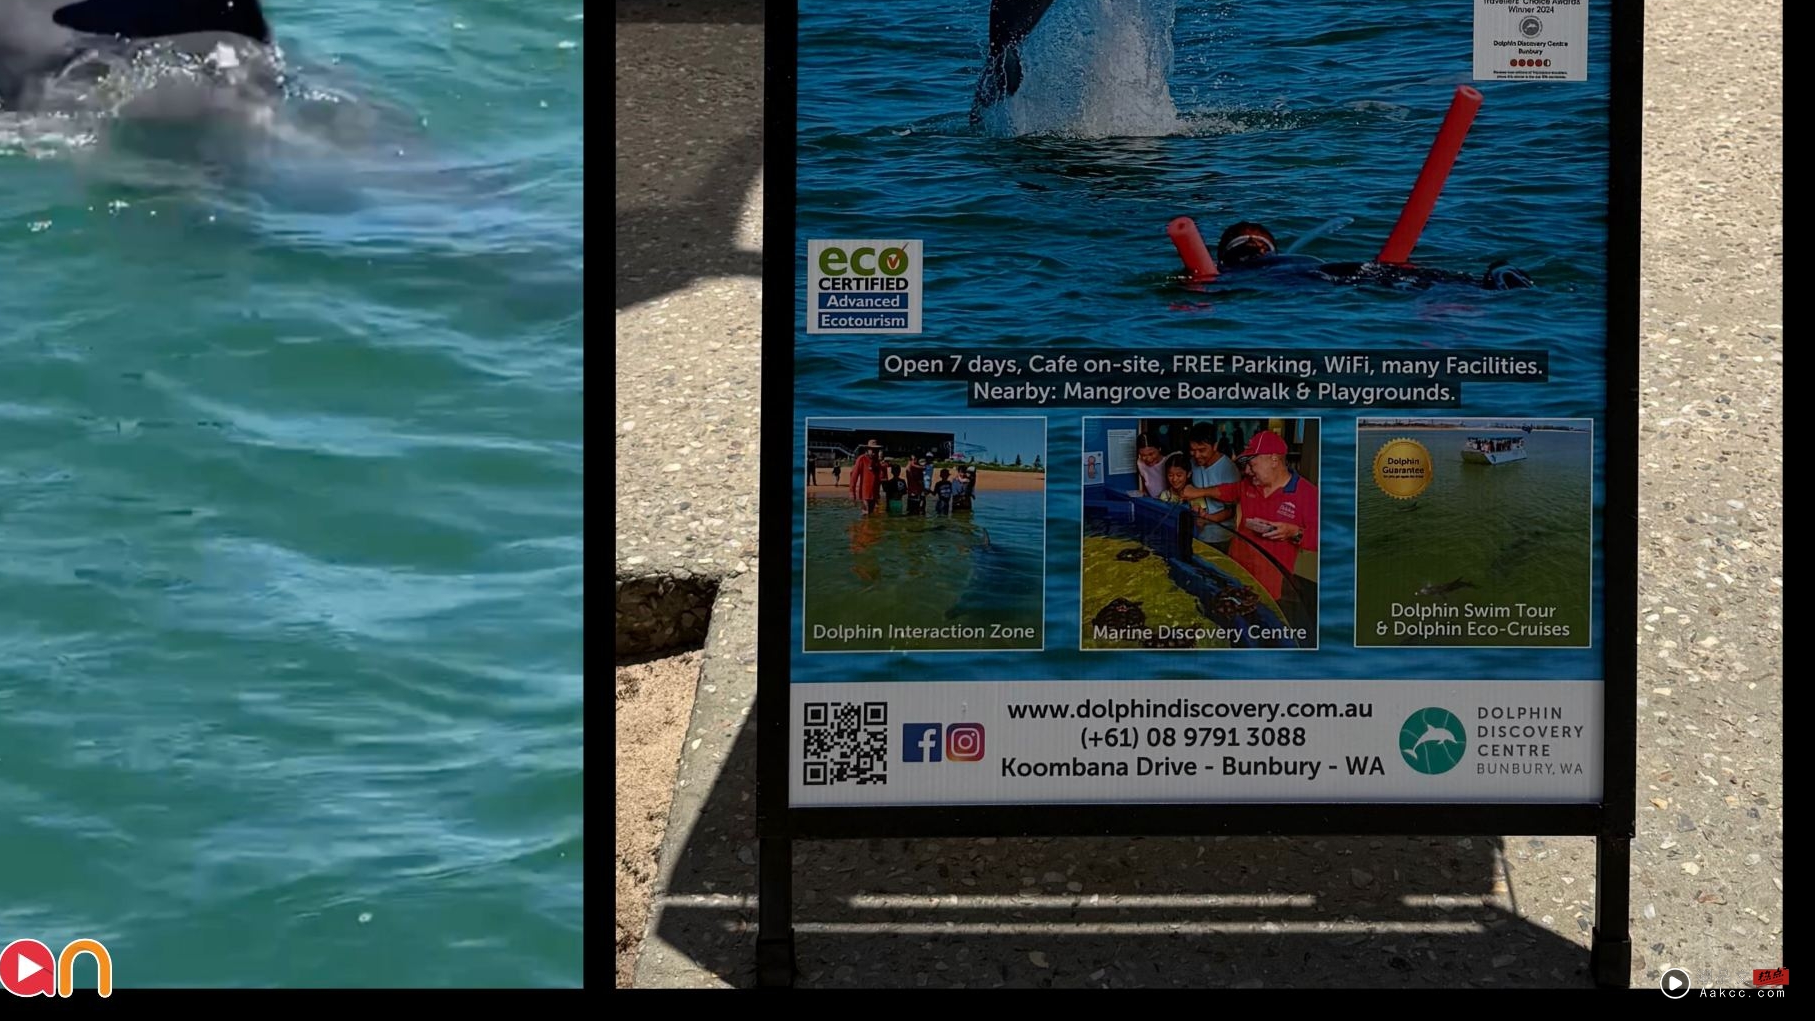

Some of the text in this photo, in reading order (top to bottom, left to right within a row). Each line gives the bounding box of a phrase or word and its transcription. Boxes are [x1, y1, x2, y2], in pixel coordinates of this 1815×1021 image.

[1493, 40, 1516, 48] Dolphin
[1517, 40, 1546, 48] Discovery
[819, 246, 909, 276] eco
[819, 277, 909, 291] CERTIFIED
[826, 294, 900, 308] Advanced
[821, 314, 905, 327] Ecotourism
[885, 355, 1542, 378] Open 7 days, Cafe on-site, FREE Parking, WiFi, many Facilities.
[975, 382, 1454, 404] Nearby: Mangrove Boardwalk & Playgrounds.
[1388, 458, 1419, 466] Dolphin
[1382, 466, 1424, 474] Guarantee
[1391, 603, 1557, 620] Dolphin Swim Tour
[813, 624, 1035, 642] Dolphin Interaction Zone
[1093, 625, 1307, 642] Marine Discovery Centre
[1376, 621, 1570, 638] & Dolphin Eco-Cruises
[1008, 699, 1372, 723] www.dolphindiscovery.com.au
[1478, 707, 1561, 719] DOLPHIN
[1082, 727, 1305, 749] (+61) 08 9791 3088
[1478, 726, 1583, 738] DISCOVERY
[1478, 745, 1549, 756] CENTRE
[1002, 757, 1128, 776] Koombana
[1137, 757, 1197, 775] Drive
[1223, 756, 1321, 780] Bunbury
[1346, 756, 1385, 775] WA
[1477, 763, 1582, 775] BUNBURY, WA
